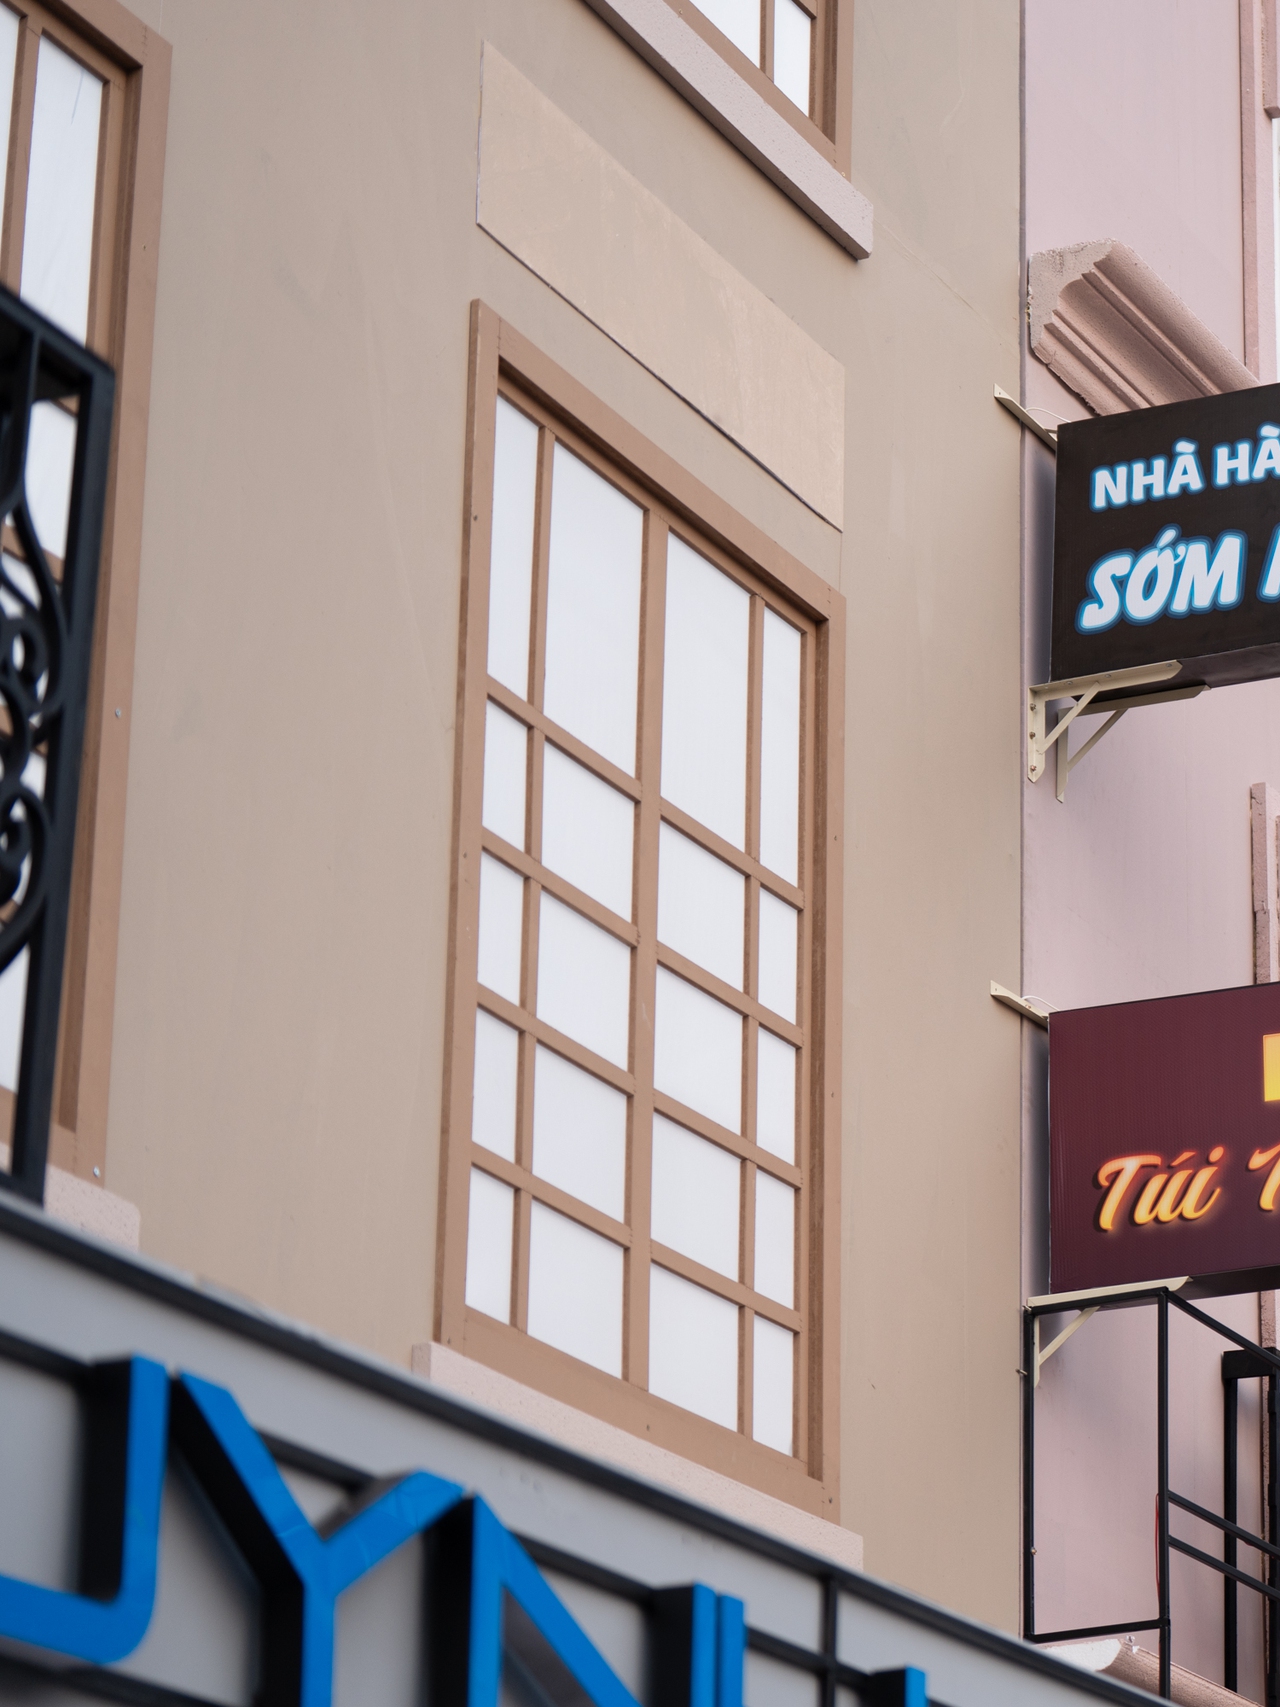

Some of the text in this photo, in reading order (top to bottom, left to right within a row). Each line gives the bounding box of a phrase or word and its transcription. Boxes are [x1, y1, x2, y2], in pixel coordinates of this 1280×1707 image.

[1092, 439, 1203, 508] NHÀ
[1079, 527, 1246, 631] SỚM
[1097, 1145, 1226, 1232] Túi
